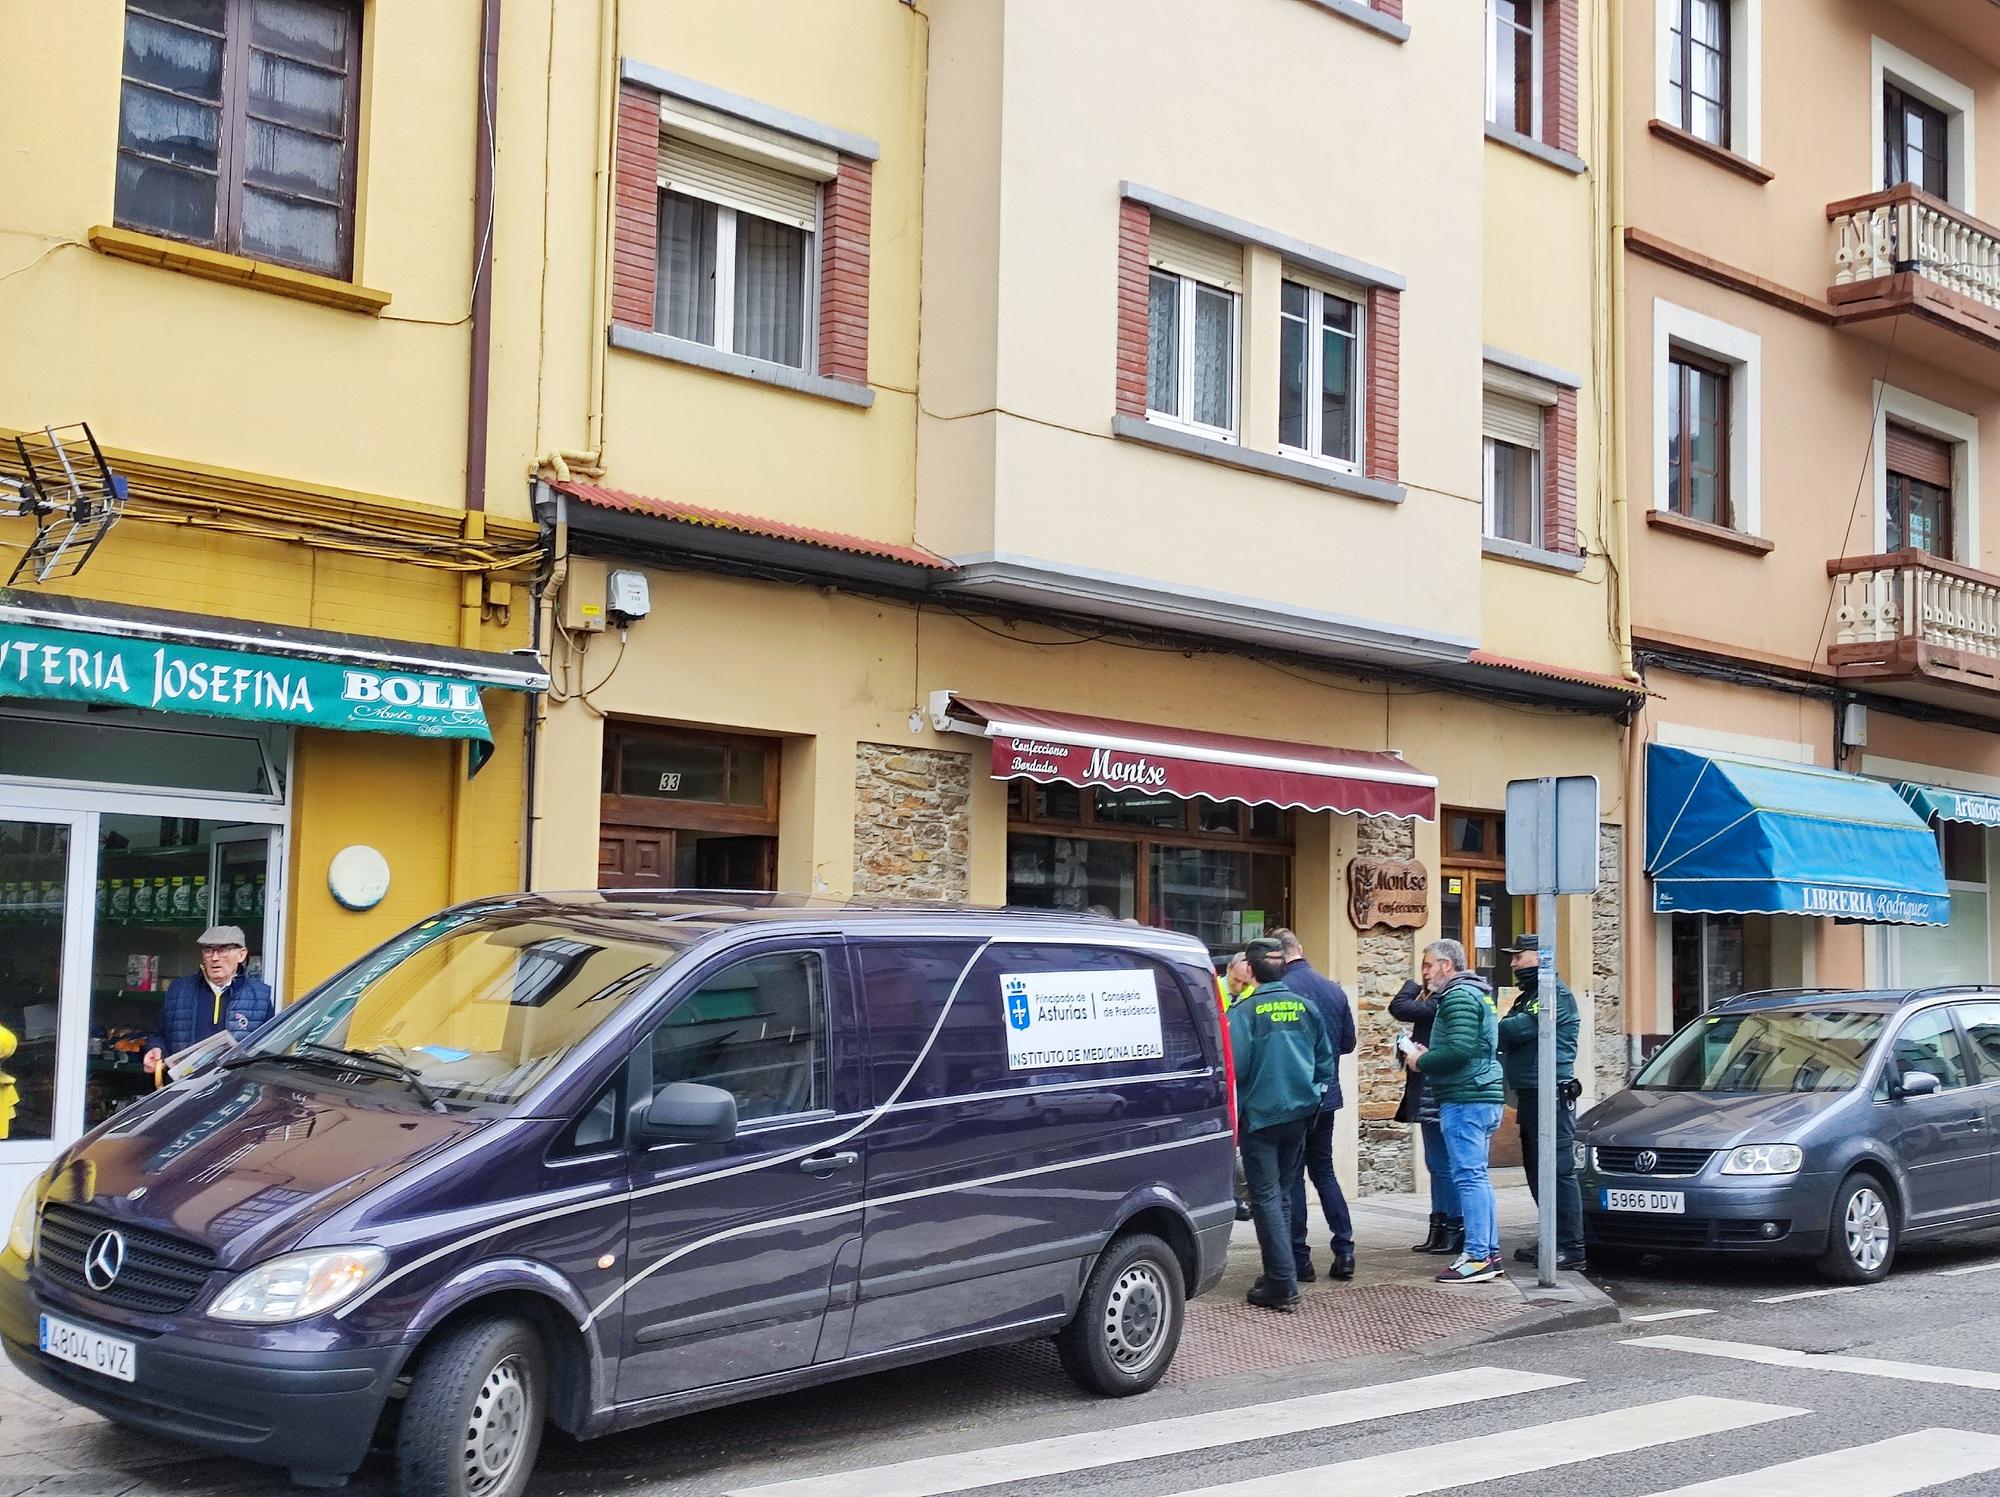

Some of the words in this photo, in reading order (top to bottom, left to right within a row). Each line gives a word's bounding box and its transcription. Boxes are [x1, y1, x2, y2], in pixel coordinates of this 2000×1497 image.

[151, 648, 314, 714] JOSEFINA
[353, 704, 413, 720] Arte
[416, 714, 438, 723] en
[1011, 738, 1069, 757] Confecciones
[1011, 756, 1059, 774] Bordados
[1082, 748, 1167, 786] Montse
[661, 774, 679, 789] 33
[1375, 868, 1427, 891] Montse
[1802, 887, 1874, 914] LIBRERIA
[1035, 992, 1075, 1004] Principado
[1076, 992, 1086, 1002] de
[1038, 1004, 1088, 1021] Asturias
[1103, 1007, 1114, 1017] de
[1115, 1004, 1157, 1016] Presidencia
[1010, 1050, 1065, 1066] INSTITUTO
[1067, 1049, 1081, 1062] DE
[1083, 1046, 1130, 1061] MEDICINA
[1131, 1044, 1161, 1057] LEGAL
[1611, 1192, 1646, 1208] 5966
[1651, 1194, 1678, 1209] DDV
[51, 1325, 89, 1361] 4804
[95, 1341, 128, 1375] GVZ
